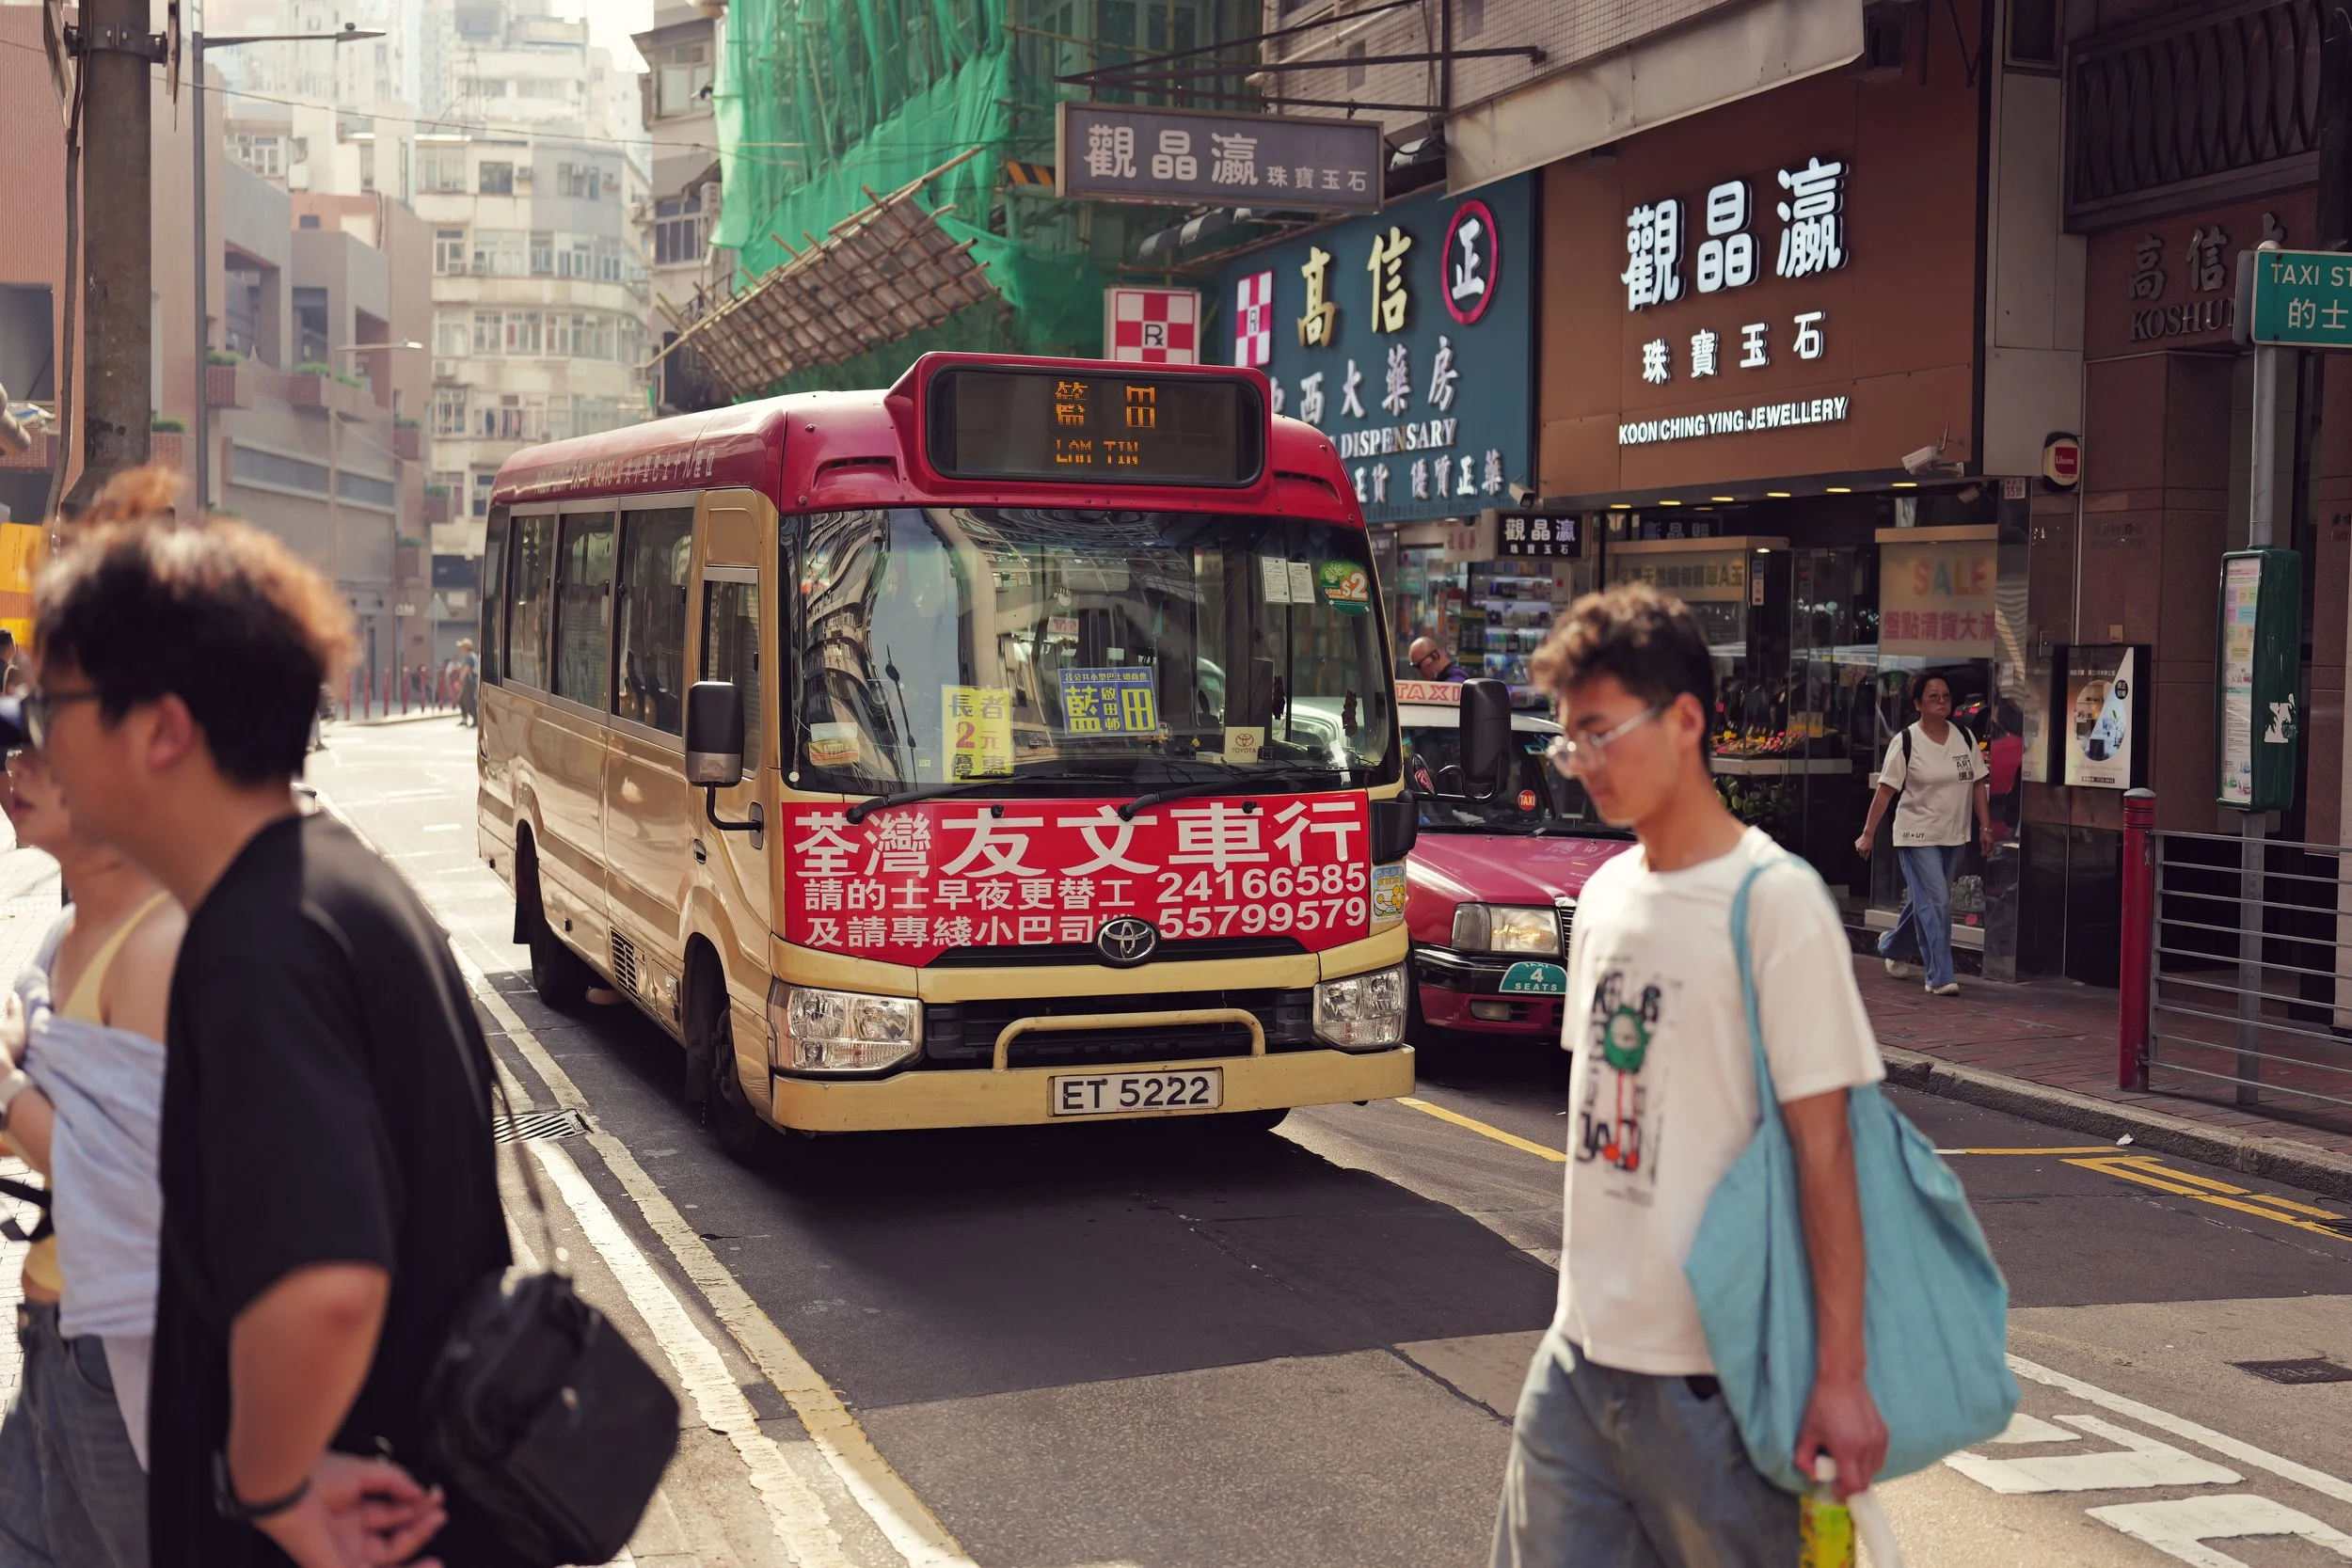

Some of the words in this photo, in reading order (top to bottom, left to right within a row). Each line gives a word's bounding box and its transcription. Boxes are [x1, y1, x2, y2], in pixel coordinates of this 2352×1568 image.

[1084, 124, 1258, 186] 觀晶瀛
[1267, 166, 1367, 191] 珠寶玉石
[1620, 156, 1847, 312] 觀晶瀛
[2271, 263, 2319, 285] TAXI
[2288, 297, 2348, 328] 的士
[1643, 311, 1823, 384] 珠寶玉石
[1619, 421, 1658, 445] KOON
[1661, 415, 1707, 441] CHING
[1708, 409, 1746, 434] YING
[1748, 397, 1848, 429] JEWELLERY
[1341, 418, 1457, 459] DISPENSARY
[1504, 518, 1576, 542] 觀晶瀛
[1510, 544, 1568, 555] 珠寶玉石
[1342, 573, 1367, 599] $2
[1914, 558, 1986, 597] SALE
[948, 694, 1004, 719] 長者
[1396, 683, 1460, 702] TAXI
[1957, 760, 1972, 768] ART
[1519, 794, 1535, 806] TAXI
[804, 877, 1135, 911] 請的士早夜更替工
[1156, 862, 1365, 903] 24166585
[804, 912, 1132, 948] 及請專綫小巴司
[1159, 896, 1366, 939] 55799579
[1530, 968, 1544, 982] 4
[1063, 1080, 1106, 1109] ET
[1120, 1076, 1209, 1107] 5222
